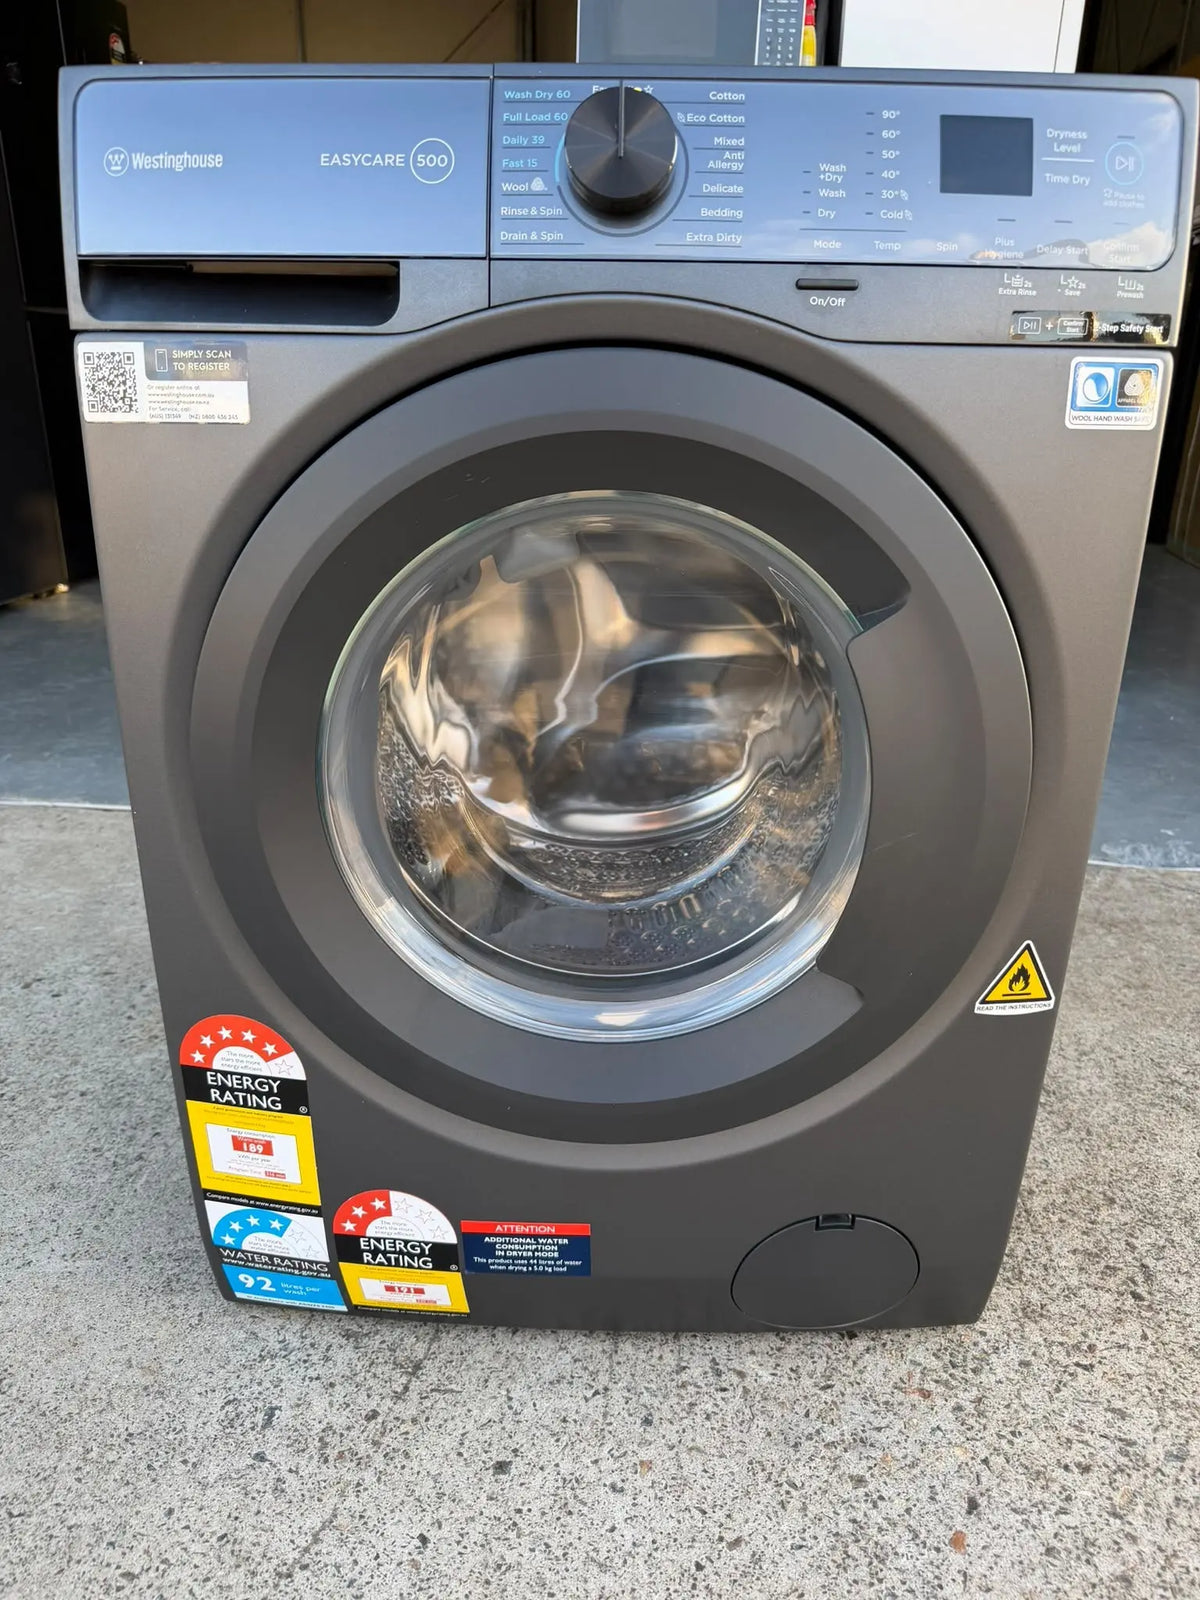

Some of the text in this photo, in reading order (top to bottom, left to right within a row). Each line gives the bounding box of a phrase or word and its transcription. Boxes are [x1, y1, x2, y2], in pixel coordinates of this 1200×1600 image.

[505, 90, 570, 101] Wash Dry 60
[709, 91, 745, 101] Cotton
[503, 113, 568, 122] Full Load 60
[687, 114, 745, 123] Eco Cotton
[1047, 129, 1088, 140] Dryness
[502, 136, 545, 146] Daily 39
[714, 137, 745, 146] Mixed
[1054, 143, 1081, 152] Level
[320, 154, 448, 167] EASYCARE 500
[724, 152, 744, 160] Anti
[132, 152, 223, 172] Westinghouse
[503, 159, 538, 168] Fast 15
[708, 160, 744, 171] Allergy
[819, 164, 847, 172] Wash
[819, 173, 843, 184] +Dry
[1045, 174, 1090, 186] Time Dry
[502, 183, 529, 192] Wool
[703, 184, 744, 193] Delicate
[819, 189, 846, 198] Wash
[501, 207, 562, 218] Rinse & Spin
[701, 208, 743, 219] Bedding
[818, 209, 836, 219] Dry
[881, 210, 903, 219] Cold
[501, 232, 564, 243] Drain & Spin
[686, 233, 742, 244] Extra Dirty
[995, 236, 1015, 247] Plus
[814, 241, 842, 249] Mode
[874, 241, 901, 252] Temp
[936, 242, 958, 251] Spin
[1036, 244, 1088, 255] Delay Start
[999, 288, 1037, 296] Extra Rinse
[1117, 291, 1144, 299] Prewash
[810, 297, 846, 307] On/Off
[1121, 324, 1144, 334] Safety
[172, 350, 232, 359] SIMPLY SCAN
[173, 362, 230, 371] TO REGISTER
[207, 1072, 281, 1094] ENERGY
[210, 1089, 282, 1110] RATING
[243, 1142, 264, 1154] 189
[207, 1193, 230, 1201] Compare
[231, 1196, 249, 1204] models
[495, 1225, 556, 1234] ATTENTION
[360, 1238, 433, 1255] ENERGY
[220, 1248, 328, 1272] WATER RATING
[363, 1253, 433, 1269] RATING
[223, 1258, 331, 1278] www.waterrating.gov.au
[238, 1274, 276, 1292] 92
[281, 1282, 304, 1291] litres
